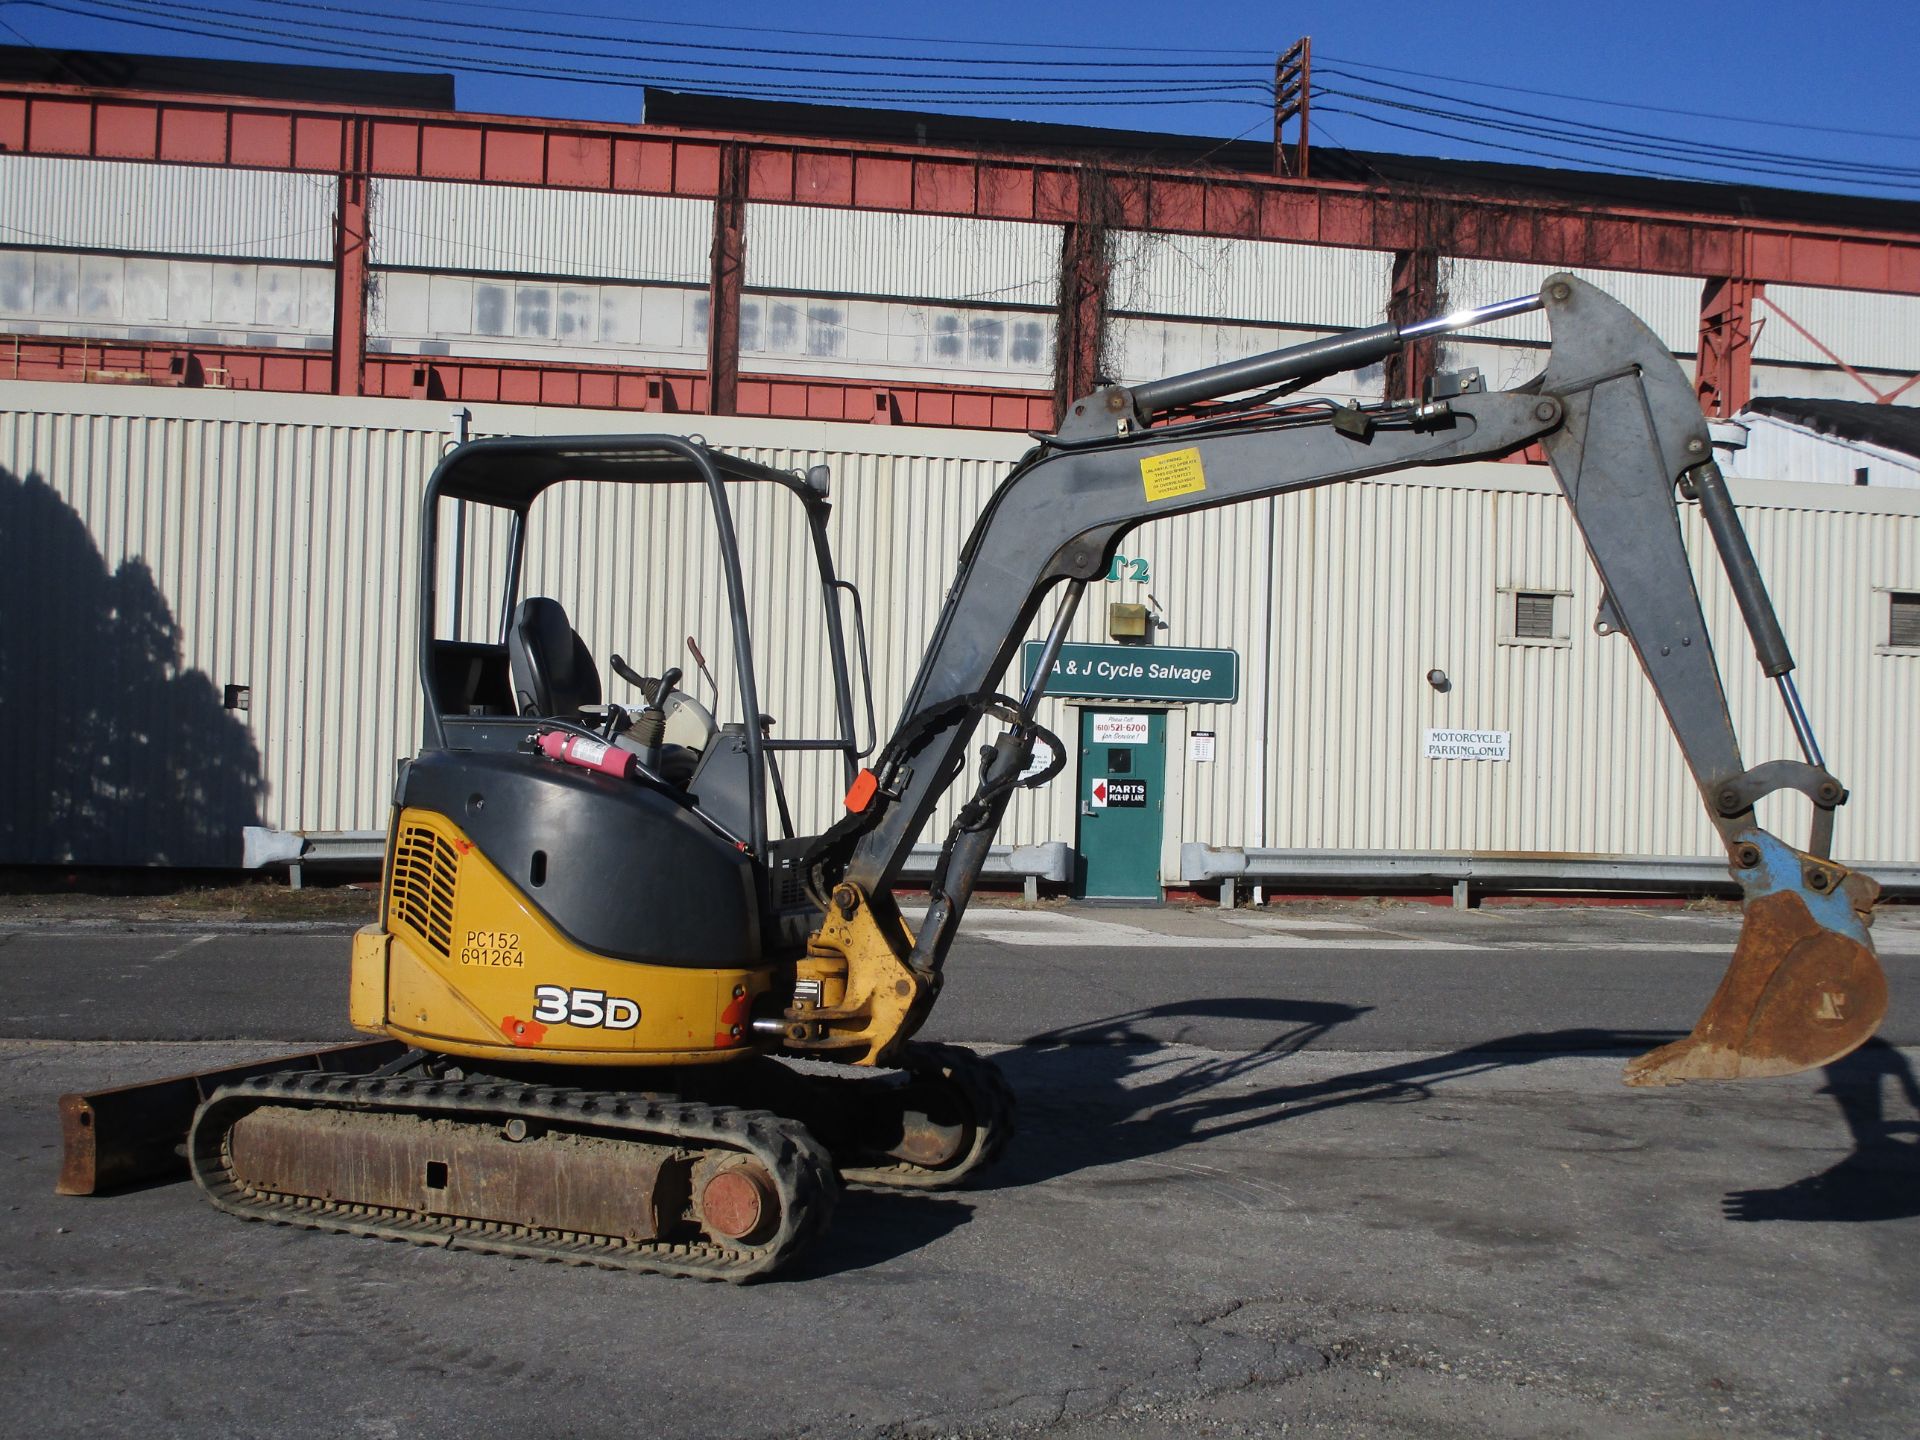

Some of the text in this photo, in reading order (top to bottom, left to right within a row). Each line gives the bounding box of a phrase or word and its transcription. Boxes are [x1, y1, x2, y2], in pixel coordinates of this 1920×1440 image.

[1051, 660, 1212, 683] A & J Cycle Salvage
[1432, 732, 1503, 744] MOTORCYCLE
[1428, 745, 1506, 757] PARKING ONLY
[1109, 785, 1145, 793] PARTS
[1109, 793, 1129, 801] PICK-UP
[467, 931, 519, 950] PC152
[461, 948, 524, 967] 691264
[532, 984, 642, 1031] 35D
